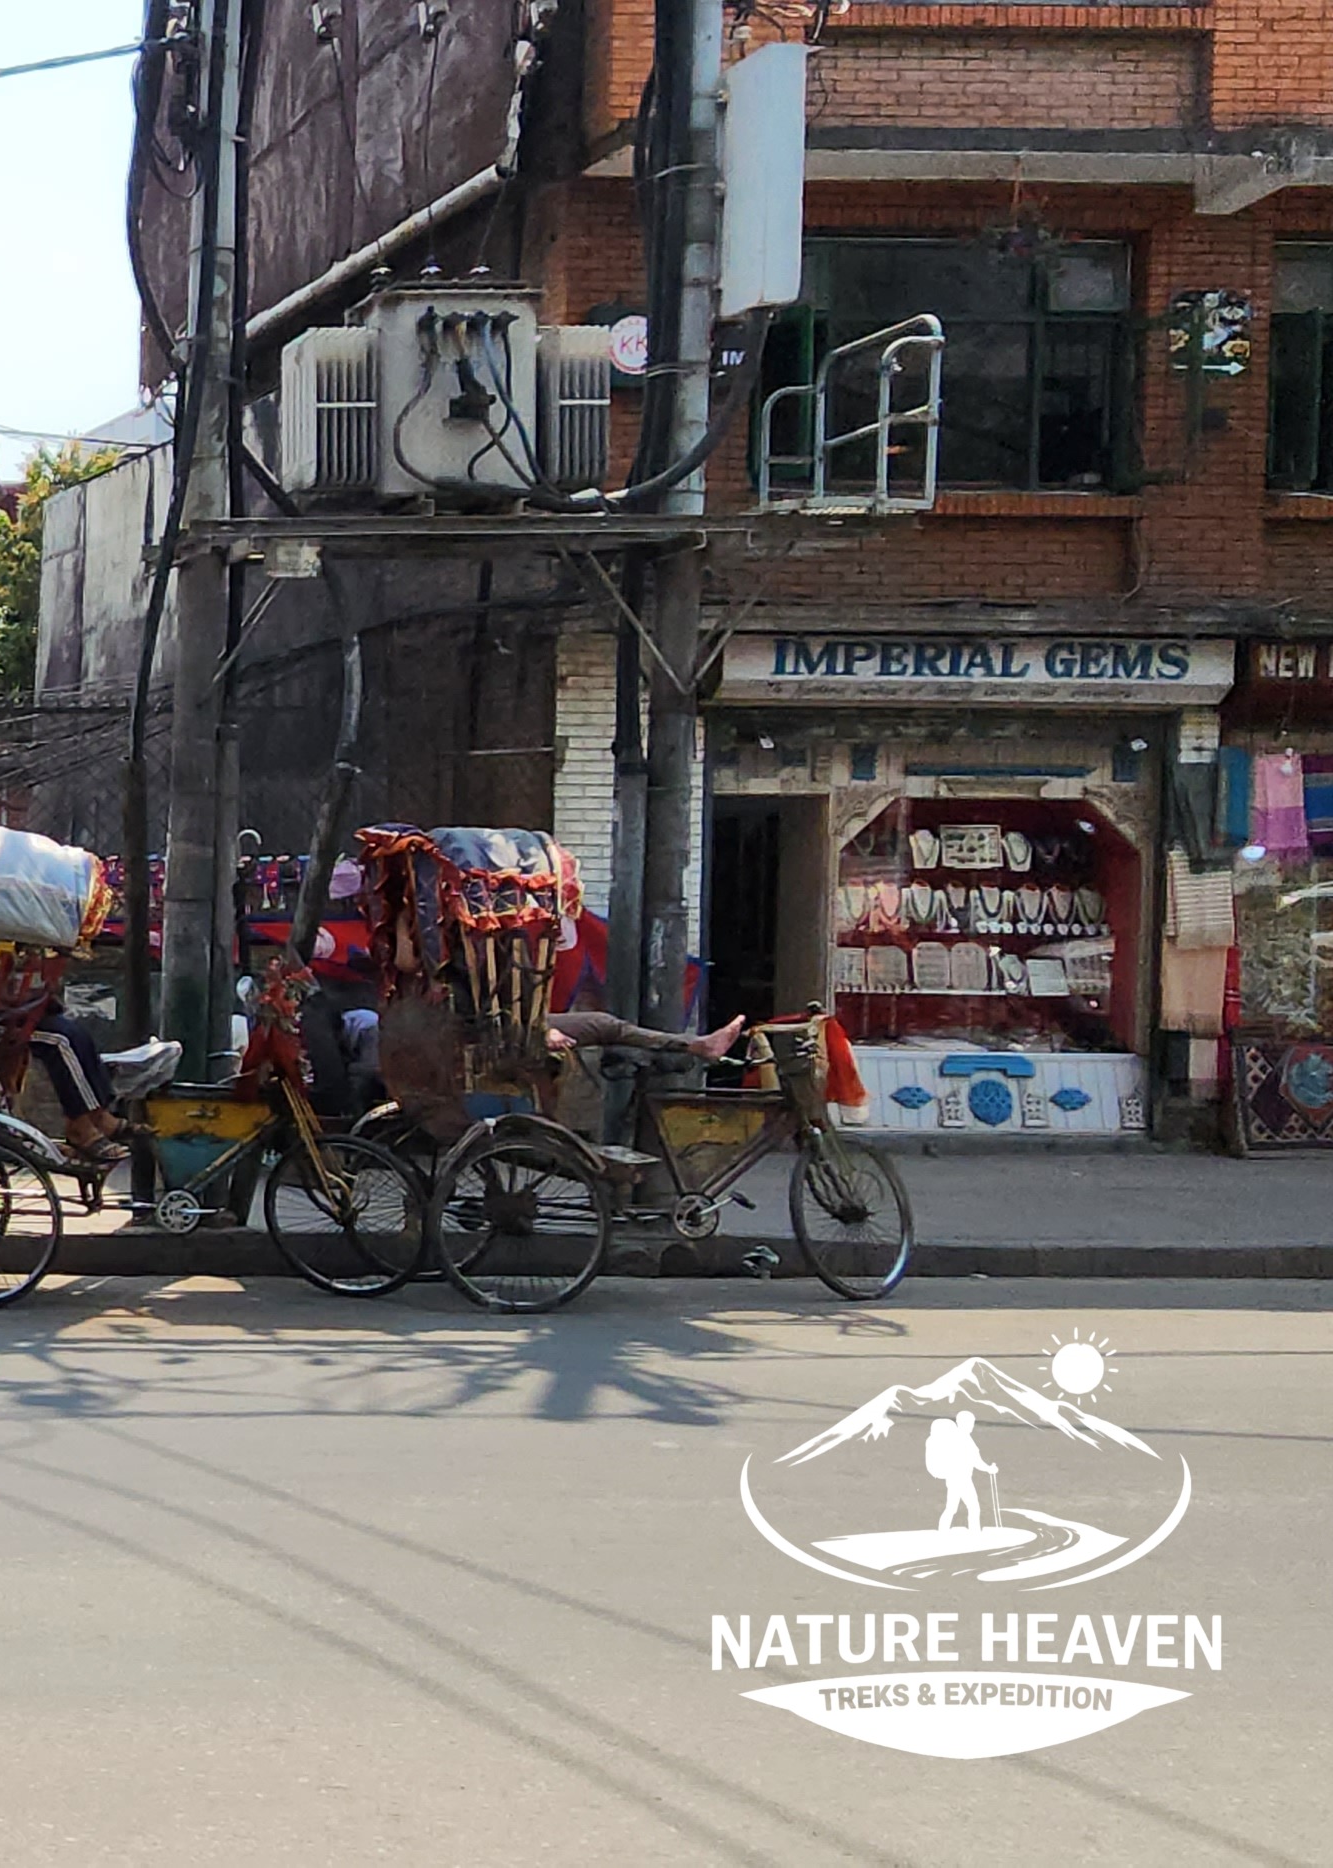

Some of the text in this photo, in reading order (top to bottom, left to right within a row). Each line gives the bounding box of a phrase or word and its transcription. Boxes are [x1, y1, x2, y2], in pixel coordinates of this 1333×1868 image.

[772, 638, 1192, 681] IMPERIAL GEMS
[1259, 644, 1316, 678] NEW
